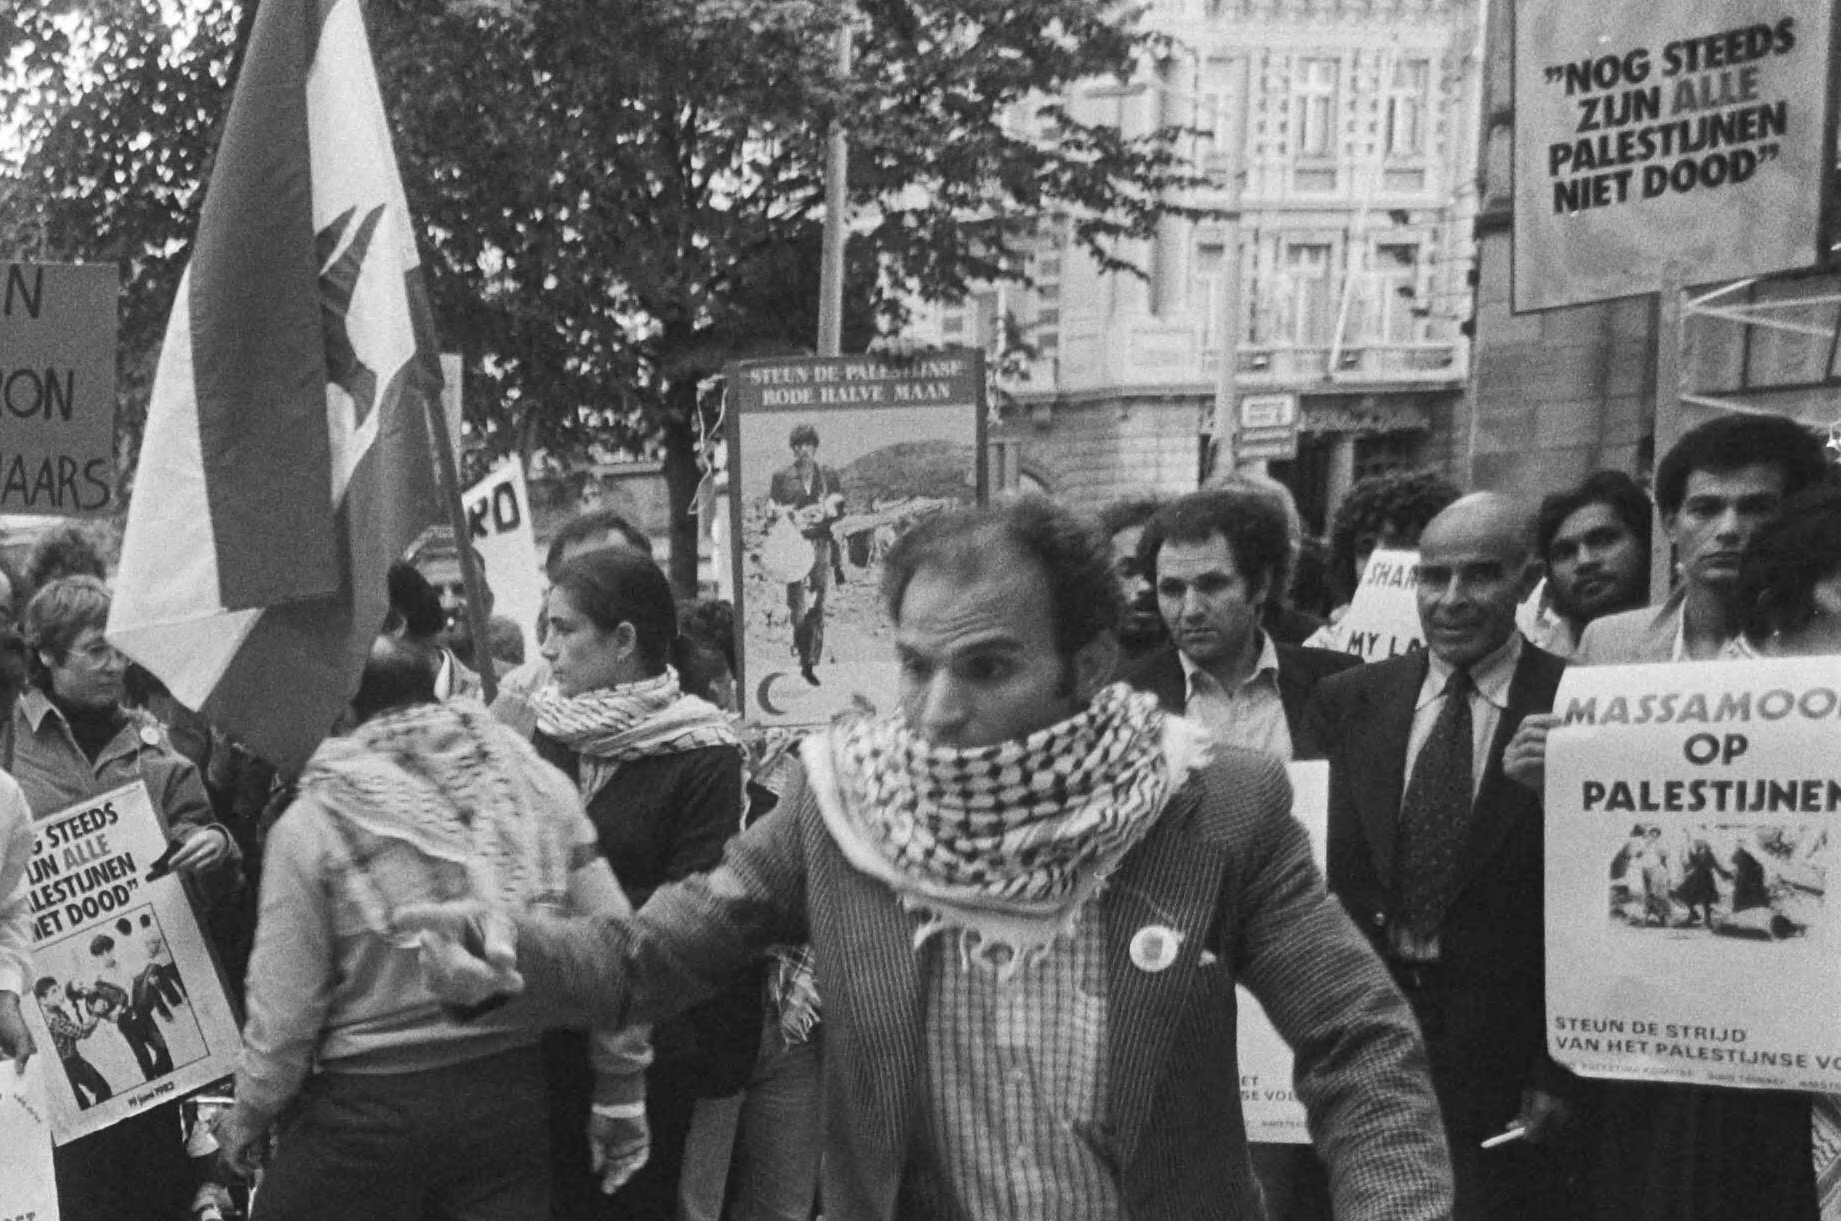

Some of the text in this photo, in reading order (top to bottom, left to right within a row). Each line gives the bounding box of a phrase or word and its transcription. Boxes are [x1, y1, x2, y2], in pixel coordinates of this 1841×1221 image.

[1662, 17, 1796, 77] STEEDS
[1576, 66, 1760, 133] ZIJN ALLE
[1549, 100, 1788, 177] PALESTIJNEN
[1553, 169, 1633, 214] NIET
[894, 382, 950, 401] MAAN
[1561, 687, 1841, 727] MASSAMOO
[1683, 732, 1749, 766] OP
[45, 801, 119, 849] STEEDS
[62, 832, 112, 872] ALLE
[1555, 1016, 1747, 1044] STEUN DE STRIJD
[1556, 1036, 1600, 1053] VAN
[1607, 1039, 1649, 1055] HET
[1656, 1043, 1808, 1070] PALESTIJNSE
